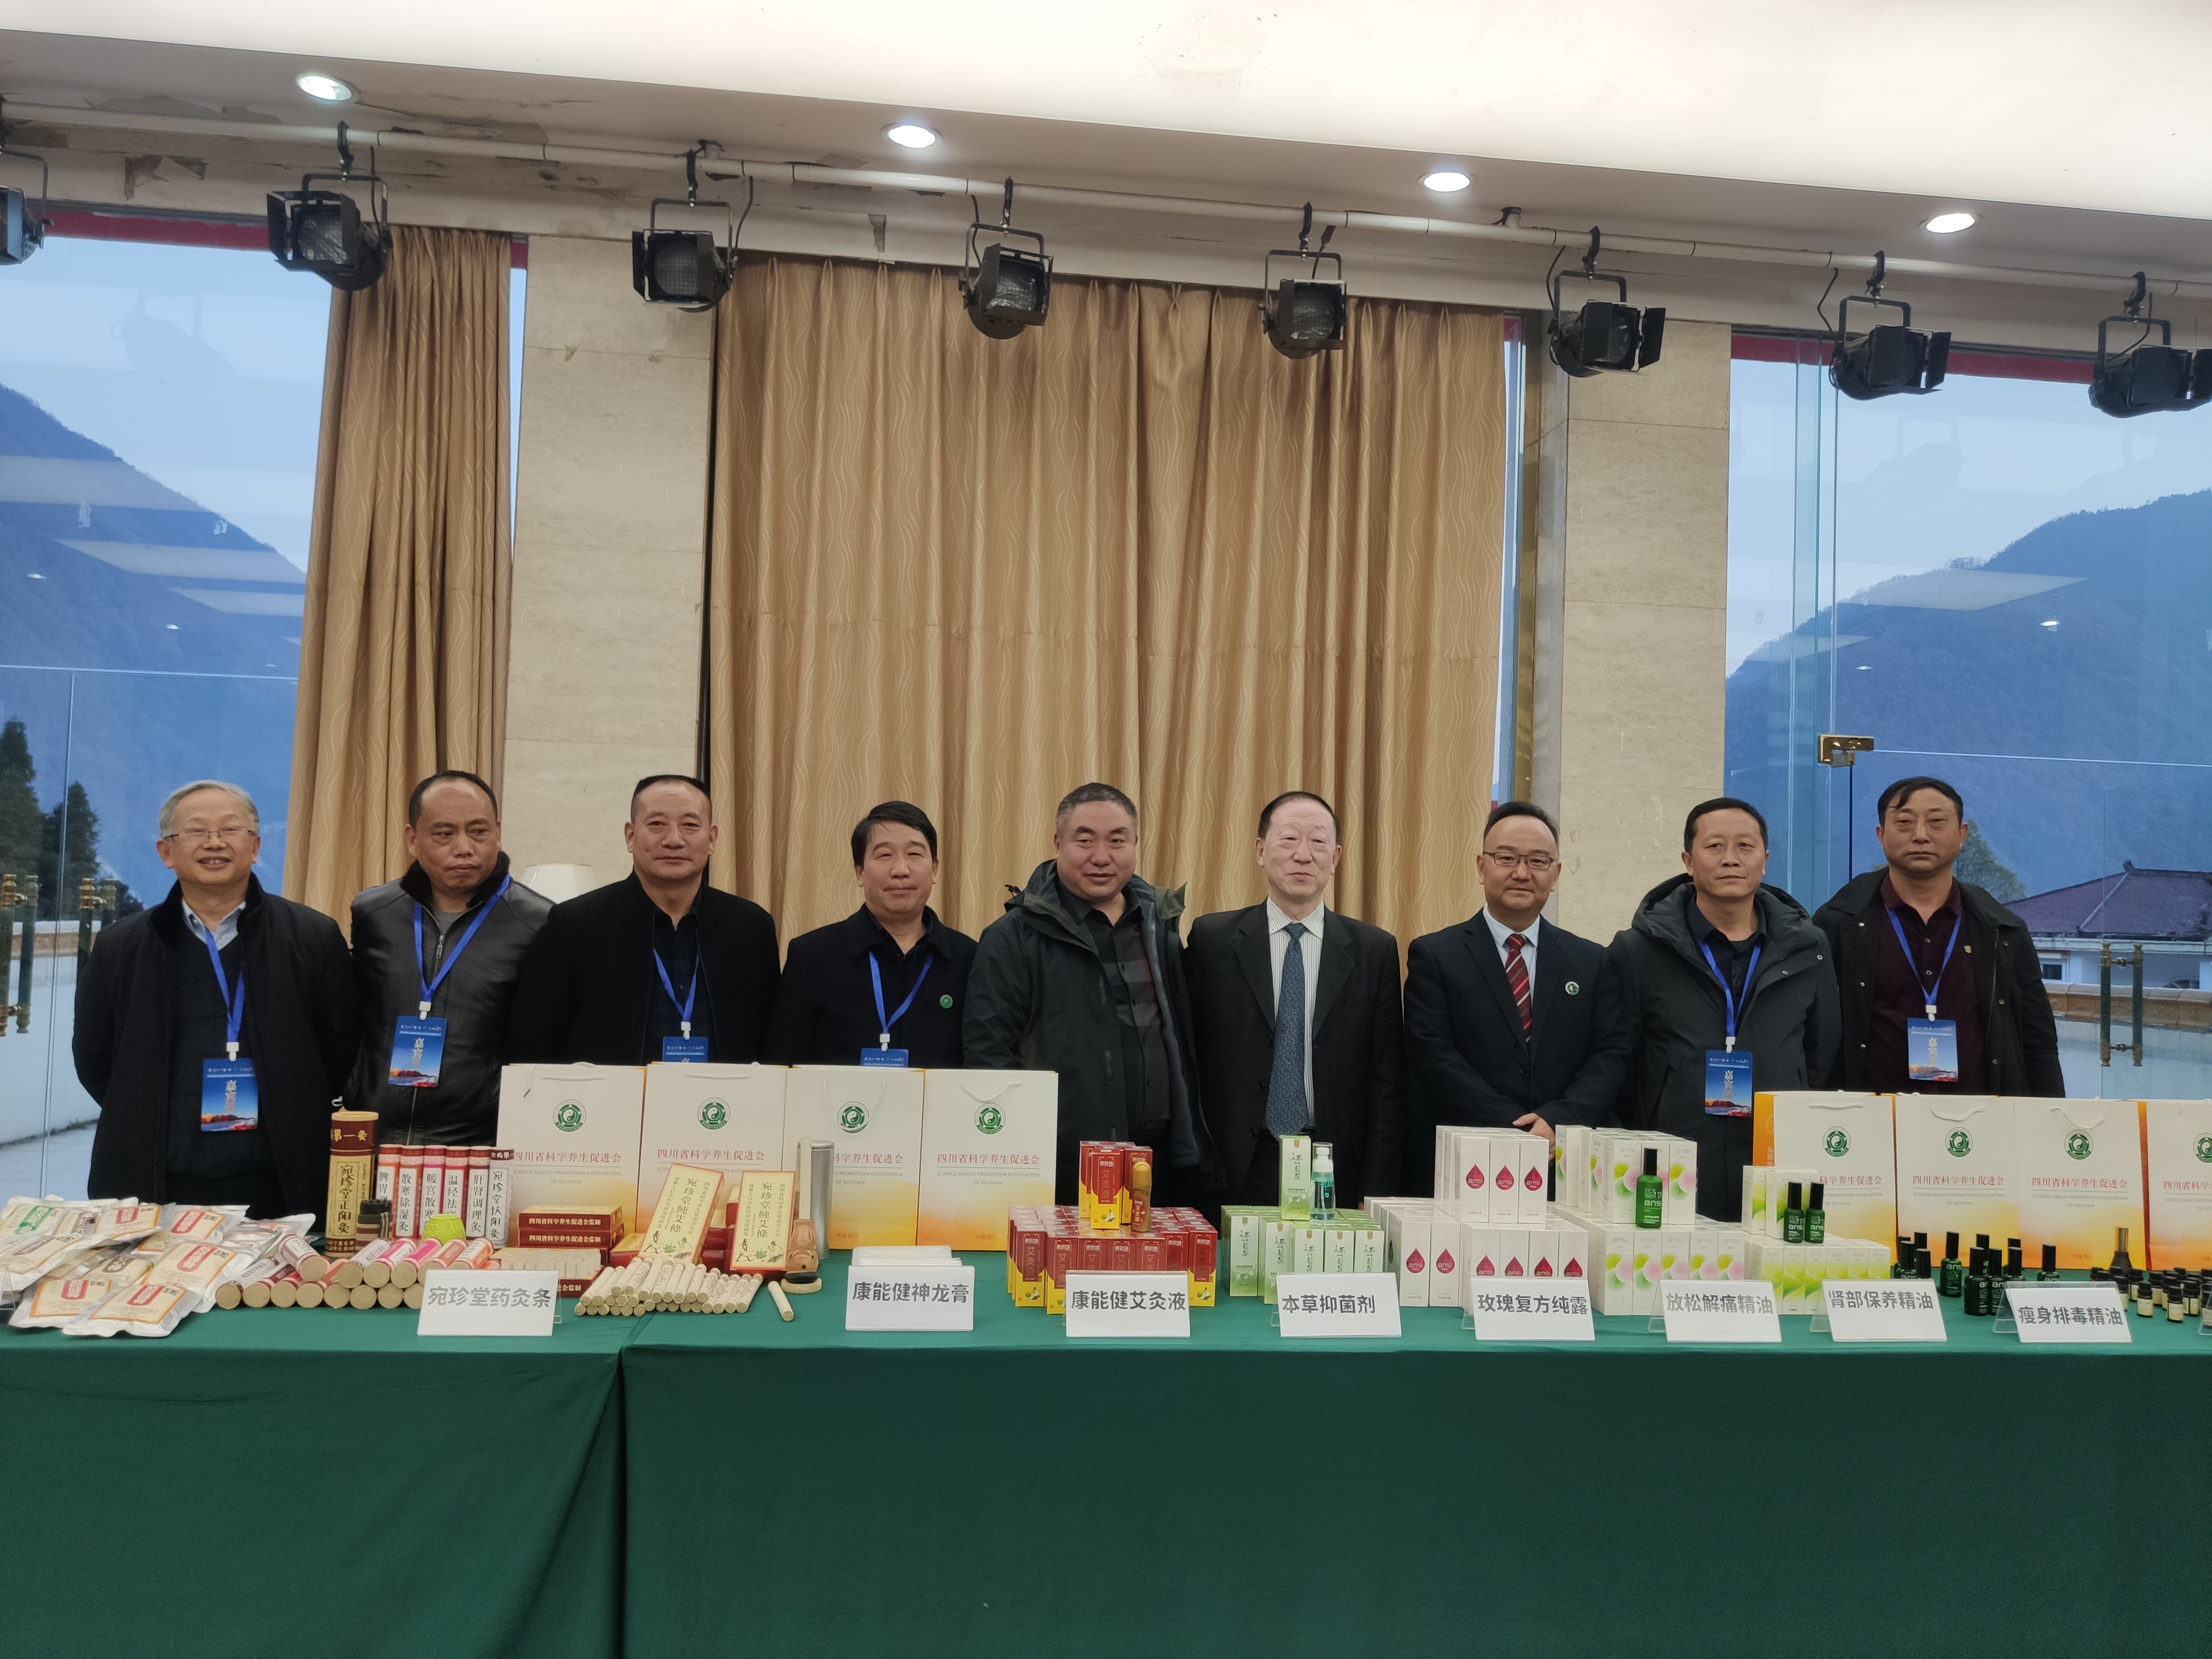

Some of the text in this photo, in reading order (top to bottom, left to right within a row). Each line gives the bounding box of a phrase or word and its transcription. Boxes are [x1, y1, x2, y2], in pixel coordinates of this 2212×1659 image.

[330, 1128, 368, 1142] 第一灸
[515, 1151, 622, 1163] 四川省科学养生促进会
[658, 1149, 765, 1161] 四川省科学养生促进会
[937, 1154, 1040, 1165] 四川省科学养生促进会
[1101, 1170, 1110, 1199] 艾灸液
[1913, 1175, 2004, 1186] 四川省科学养生促进会
[2032, 1177, 2127, 1188] 四川省科学养生促进会
[338, 1164, 354, 1234] 宛珍堂正阳灸
[398, 1173, 411, 1232] 散寒除湿灸
[424, 1173, 437, 1225] 暖宫散寒
[471, 1175, 484, 1232] 肝肾调理灸
[490, 1171, 503, 1239] 宛珍堂扶阳灸
[1026, 1246, 1035, 1276] 艾灸液
[428, 1286, 550, 1308] 宛珍堂药灸条
[852, 1281, 969, 1303] 康能健神龙膏
[1071, 1290, 1186, 1311] 康能健艾灸液
[1828, 1290, 1933, 1310] 肾部保养精油
[1282, 1294, 1375, 1314] 本草抑菌剂
[1477, 1293, 1588, 1314] 玫瑰复方纯露
[1666, 1292, 1774, 1314] 放松解痛精油
[2018, 1305, 2123, 1326] 瘦身排毒精油
